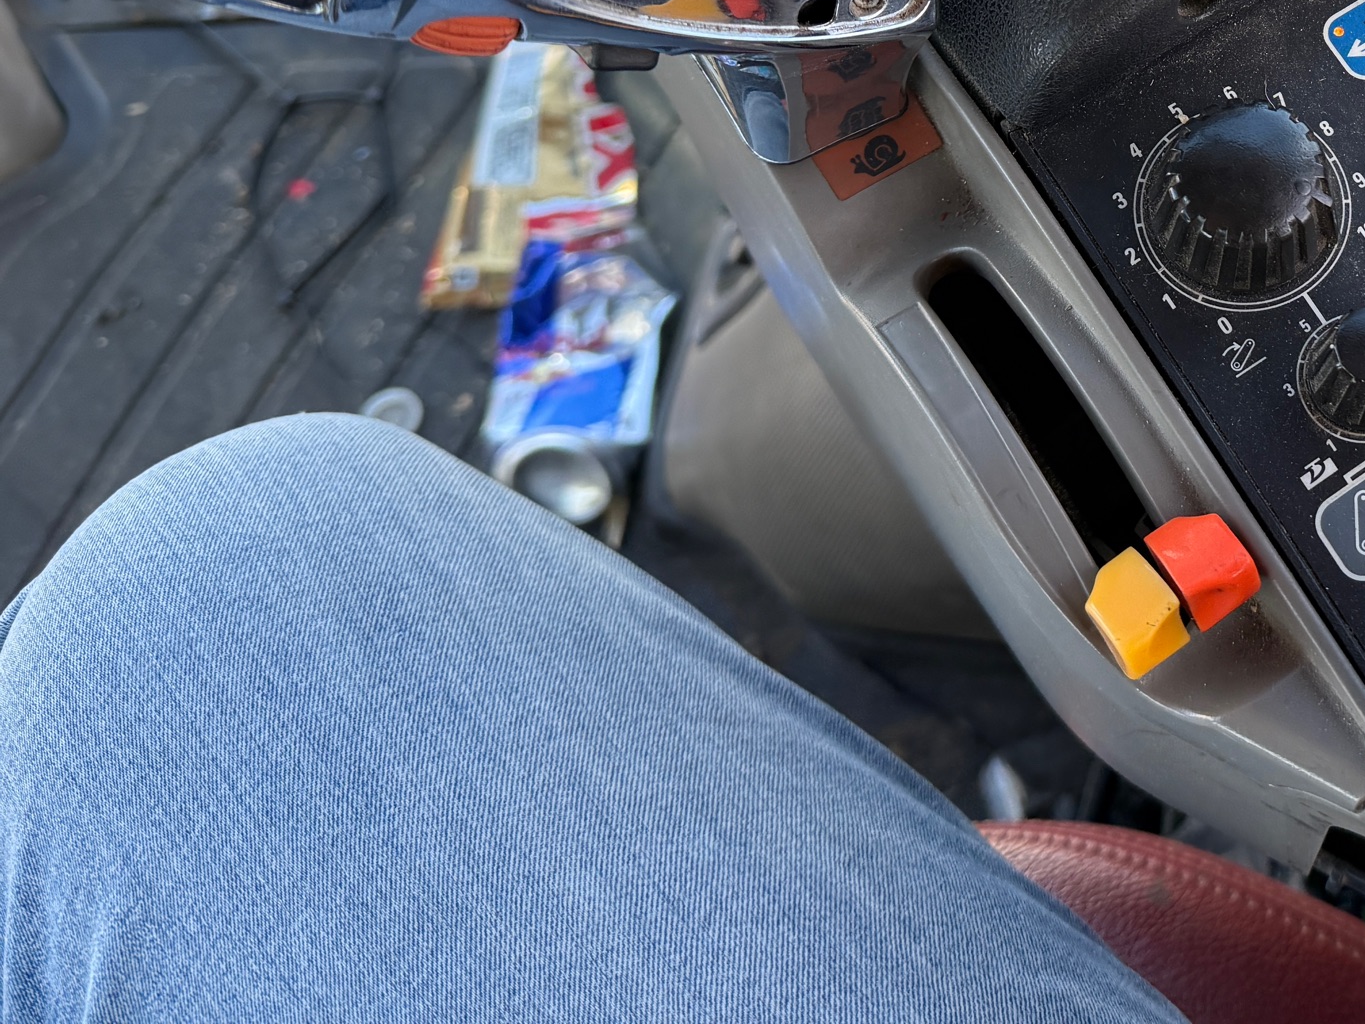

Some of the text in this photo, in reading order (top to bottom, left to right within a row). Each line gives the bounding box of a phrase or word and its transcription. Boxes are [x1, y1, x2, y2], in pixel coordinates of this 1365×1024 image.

[1167, 102, 1186, 122] 5
[1319, 120, 1334, 137] 8
[1129, 142, 1143, 159] 4
[1112, 191, 1128, 210] 3
[1124, 247, 1141, 266] 2
[1162, 293, 1177, 310] 1
[1217, 316, 1233, 334] 0
[1299, 318, 1312, 333] 5
[1283, 383, 1295, 397] 3
[1326, 439, 1339, 452] 1
